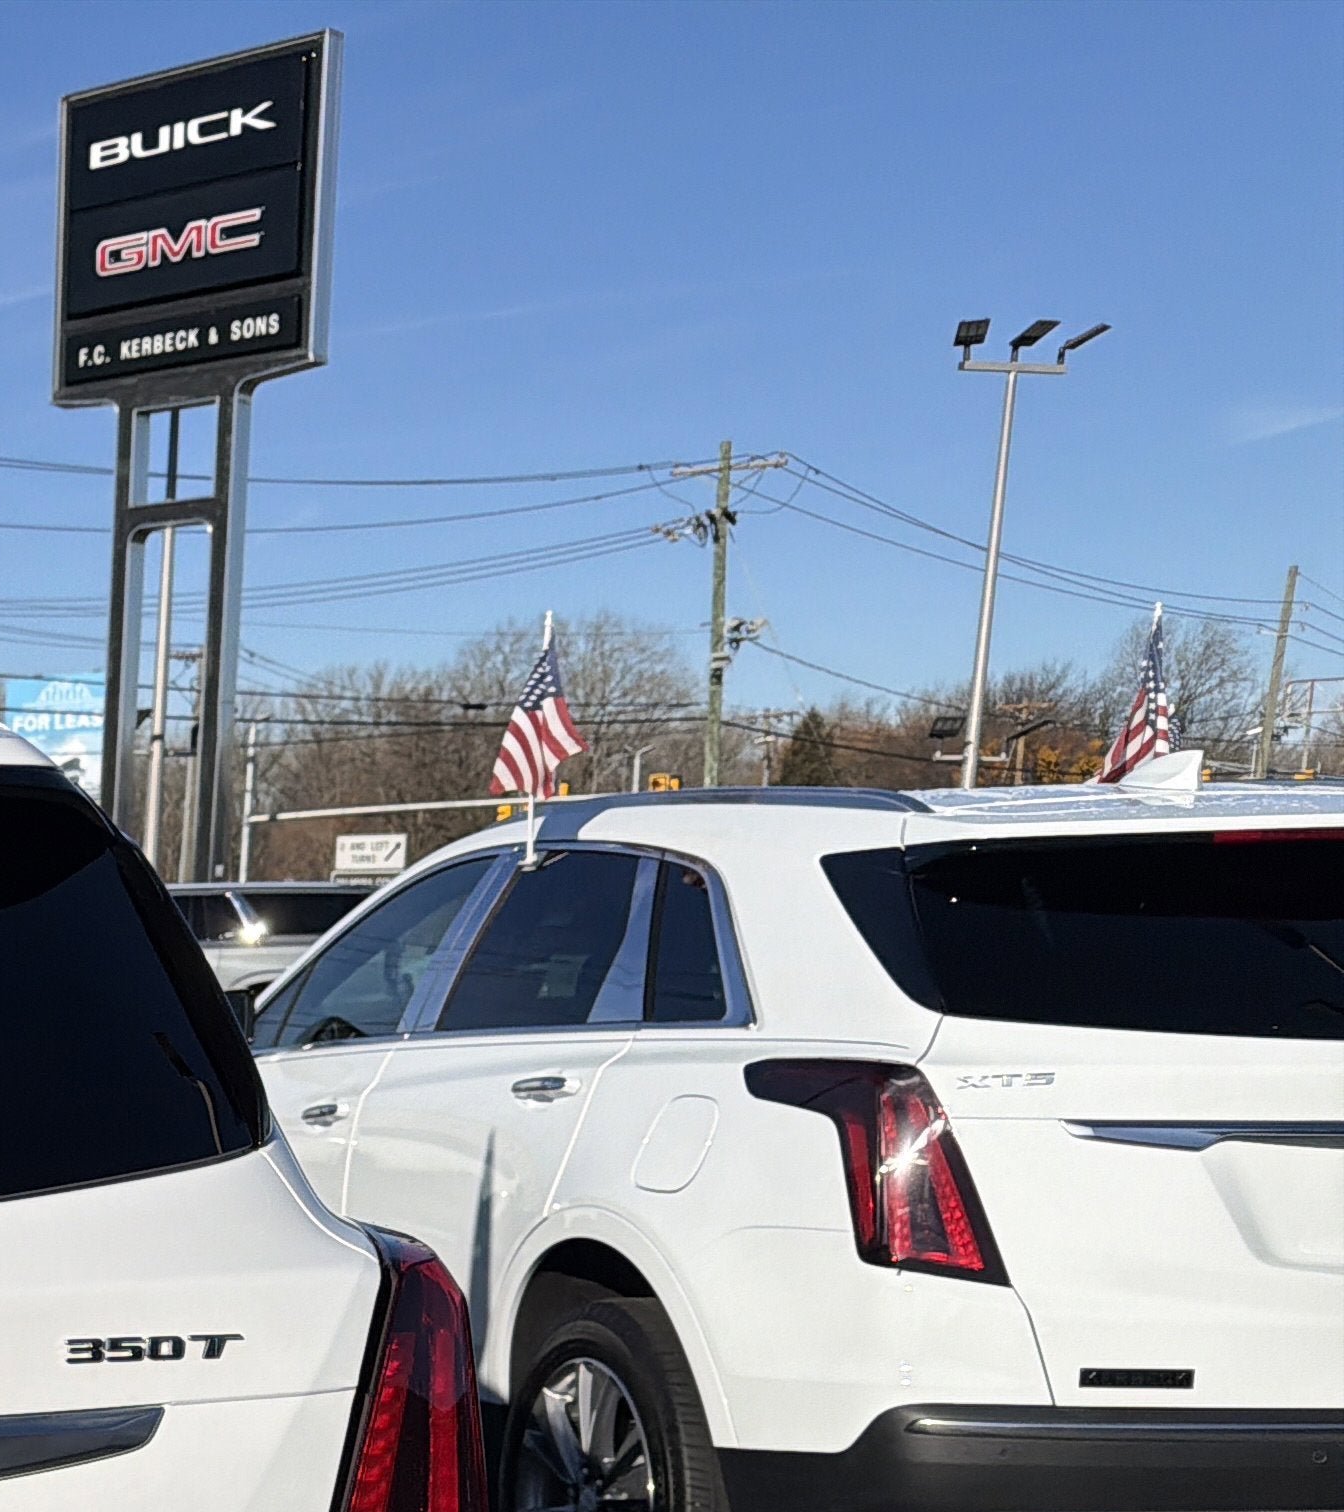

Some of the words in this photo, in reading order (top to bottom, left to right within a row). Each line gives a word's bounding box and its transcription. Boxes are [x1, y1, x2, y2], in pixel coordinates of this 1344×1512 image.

[89, 101, 277, 170] BUICK
[96, 206, 263, 277] GMC
[78, 345, 112, 368] F.C.
[120, 327, 200, 361] KERBECK
[208, 326, 219, 345] &
[230, 313, 280, 341] SONS
[13, 712, 50, 733] FOR
[53, 712, 104, 730] LEAS
[65, 1334, 245, 1364] 350T
